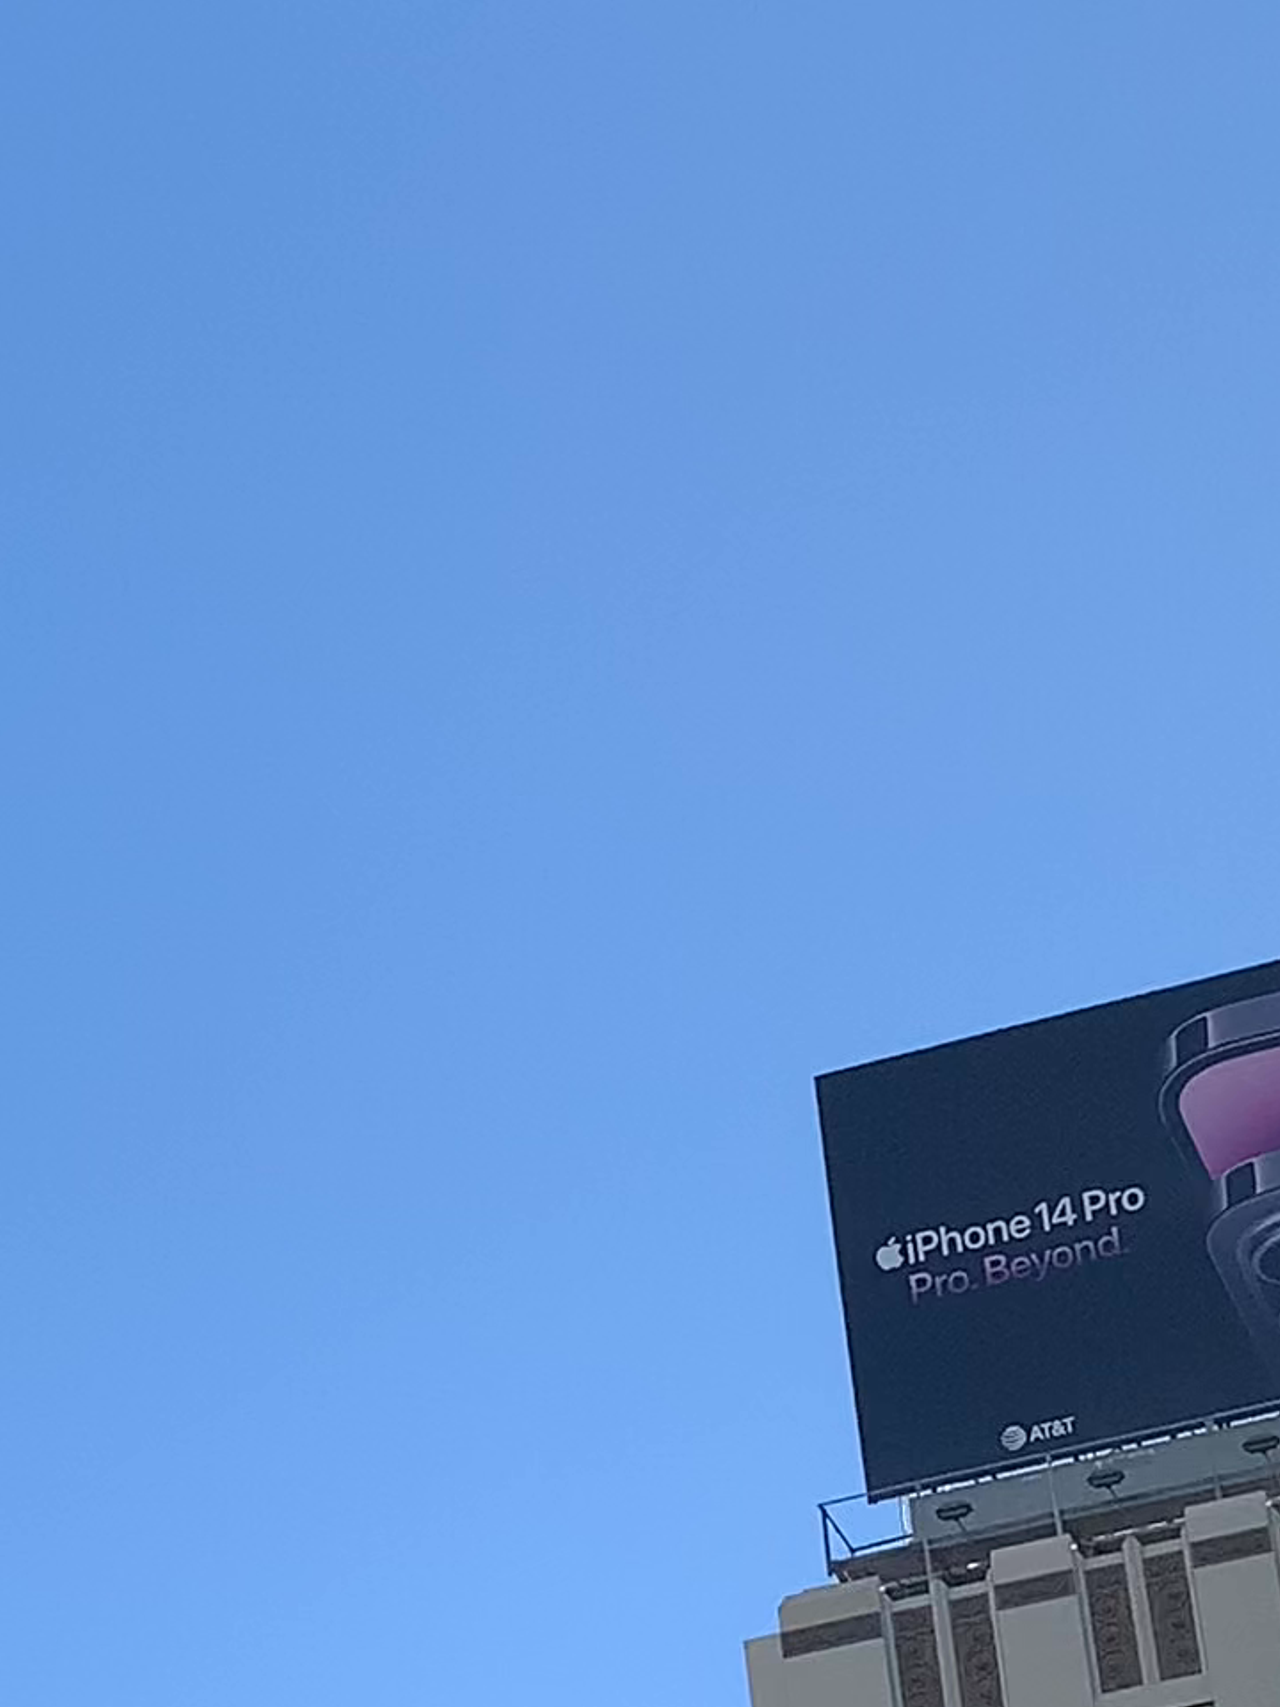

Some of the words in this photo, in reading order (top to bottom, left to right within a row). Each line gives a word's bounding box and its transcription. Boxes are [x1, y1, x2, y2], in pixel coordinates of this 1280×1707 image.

[905, 1214, 1032, 1266] iPhone
[1033, 1195, 1078, 1232] 14
[1081, 1186, 1146, 1223] Pro
[1029, 1415, 1076, 1443] AT&T
